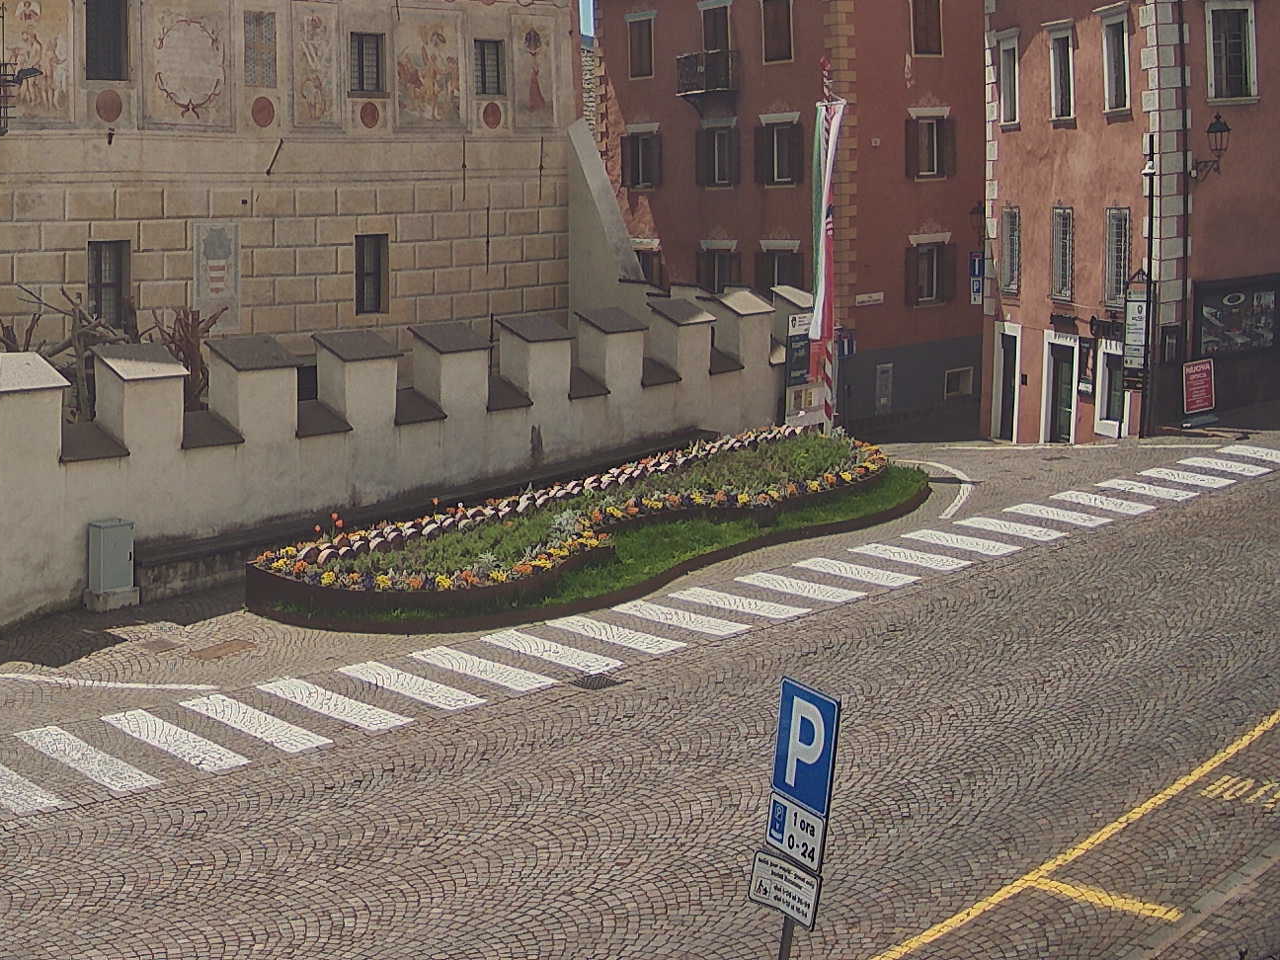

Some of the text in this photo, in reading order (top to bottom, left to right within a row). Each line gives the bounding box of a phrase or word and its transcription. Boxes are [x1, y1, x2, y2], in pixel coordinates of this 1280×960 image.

[785, 695, 826, 787] P
[793, 812, 816, 838] 1 ora
